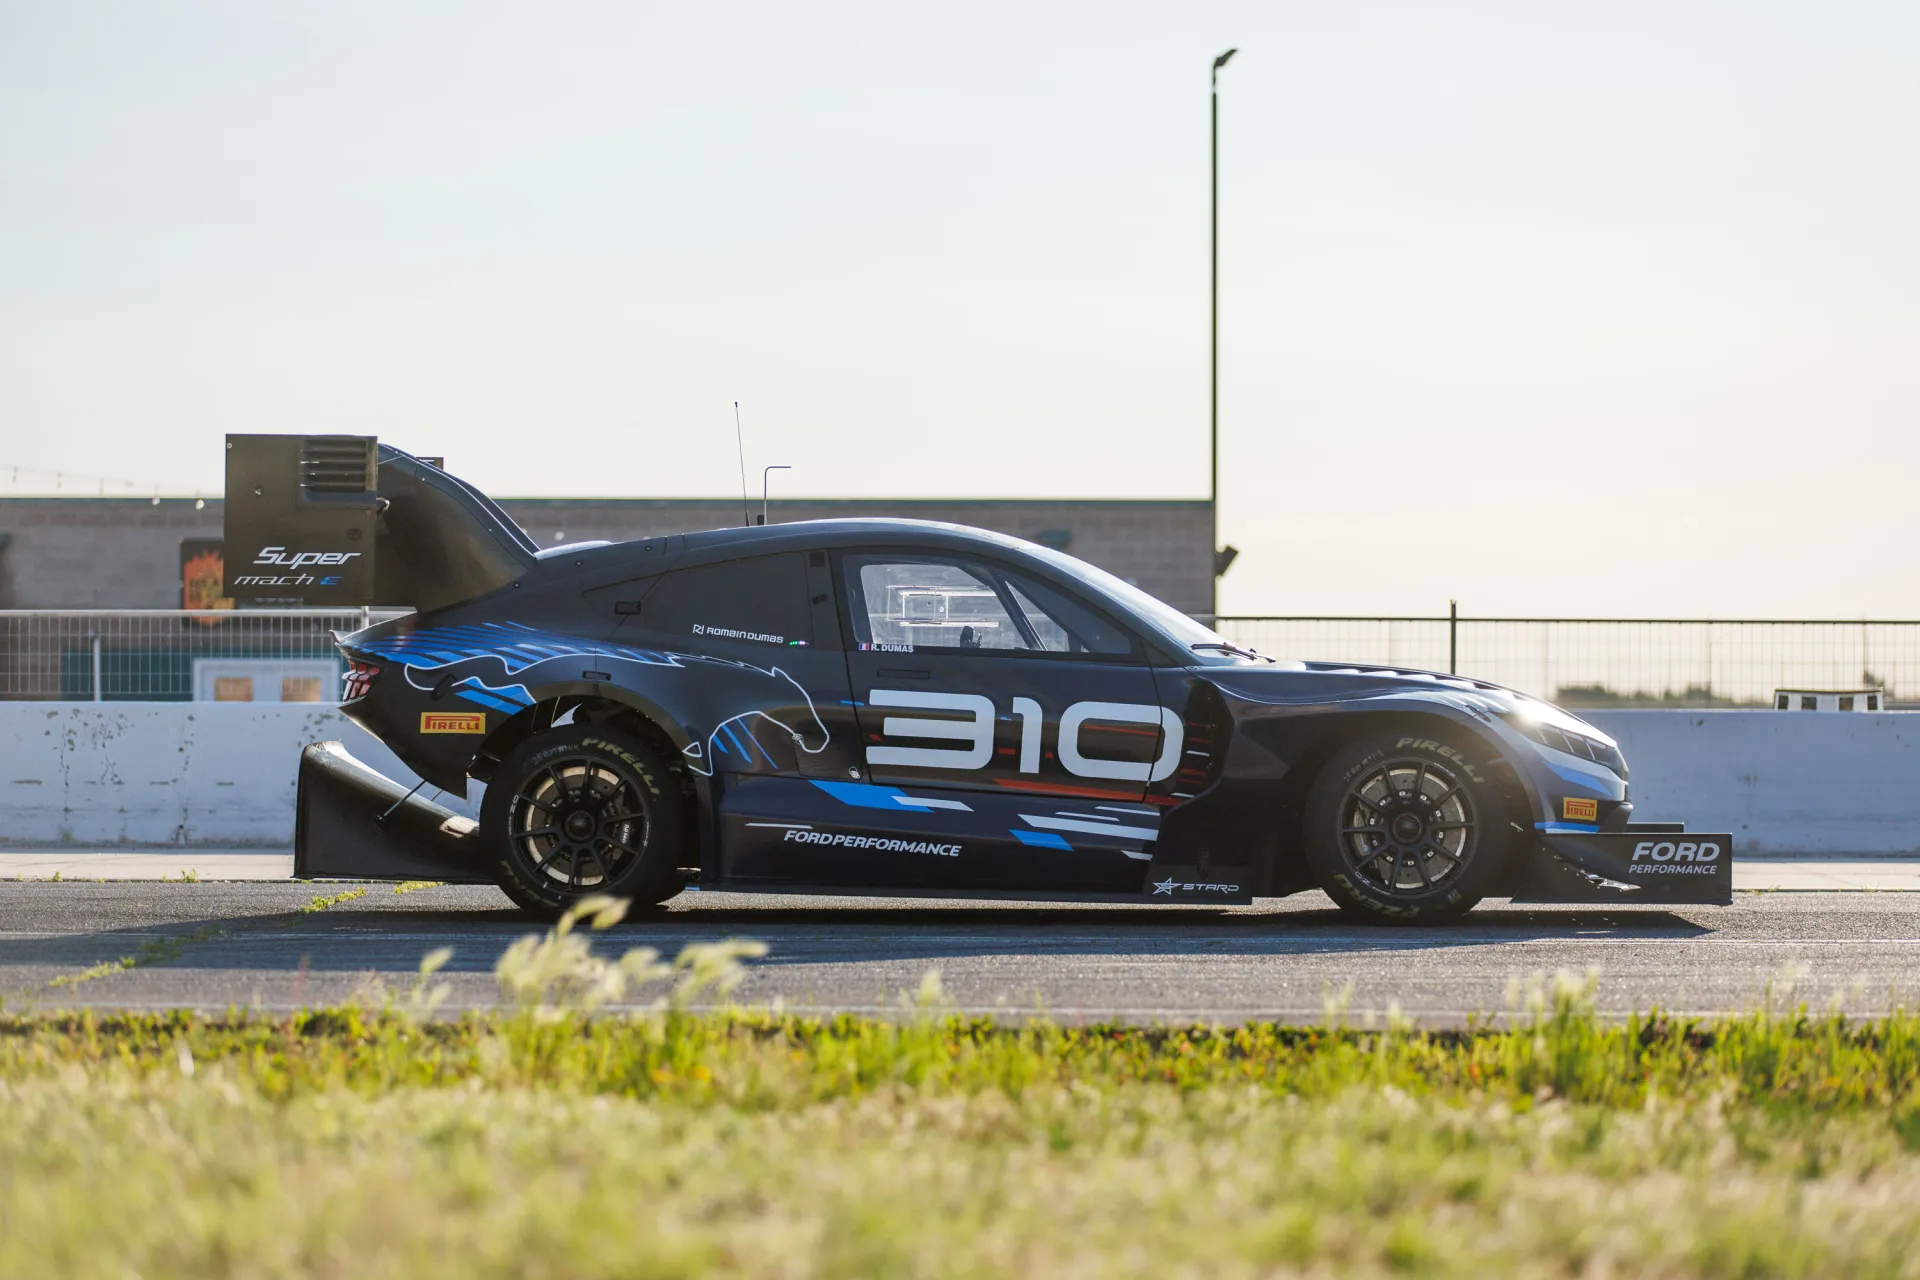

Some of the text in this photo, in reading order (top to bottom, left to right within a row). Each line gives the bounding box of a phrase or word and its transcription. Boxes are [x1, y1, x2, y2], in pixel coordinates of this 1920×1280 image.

[253, 546, 361, 570] Super
[870, 643, 914, 653] R. DUMAS
[424, 715, 481, 730] PIRELLI
[866, 689, 1184, 782] 310
[581, 737, 661, 795] PIRELLI
[1396, 737, 1486, 784] PIRELLI
[1566, 801, 1595, 817] PIRELLI
[1631, 842, 1720, 862] FORD
[1629, 864, 1717, 875] PERFORMANCE
[1182, 883, 1239, 894] STARD
